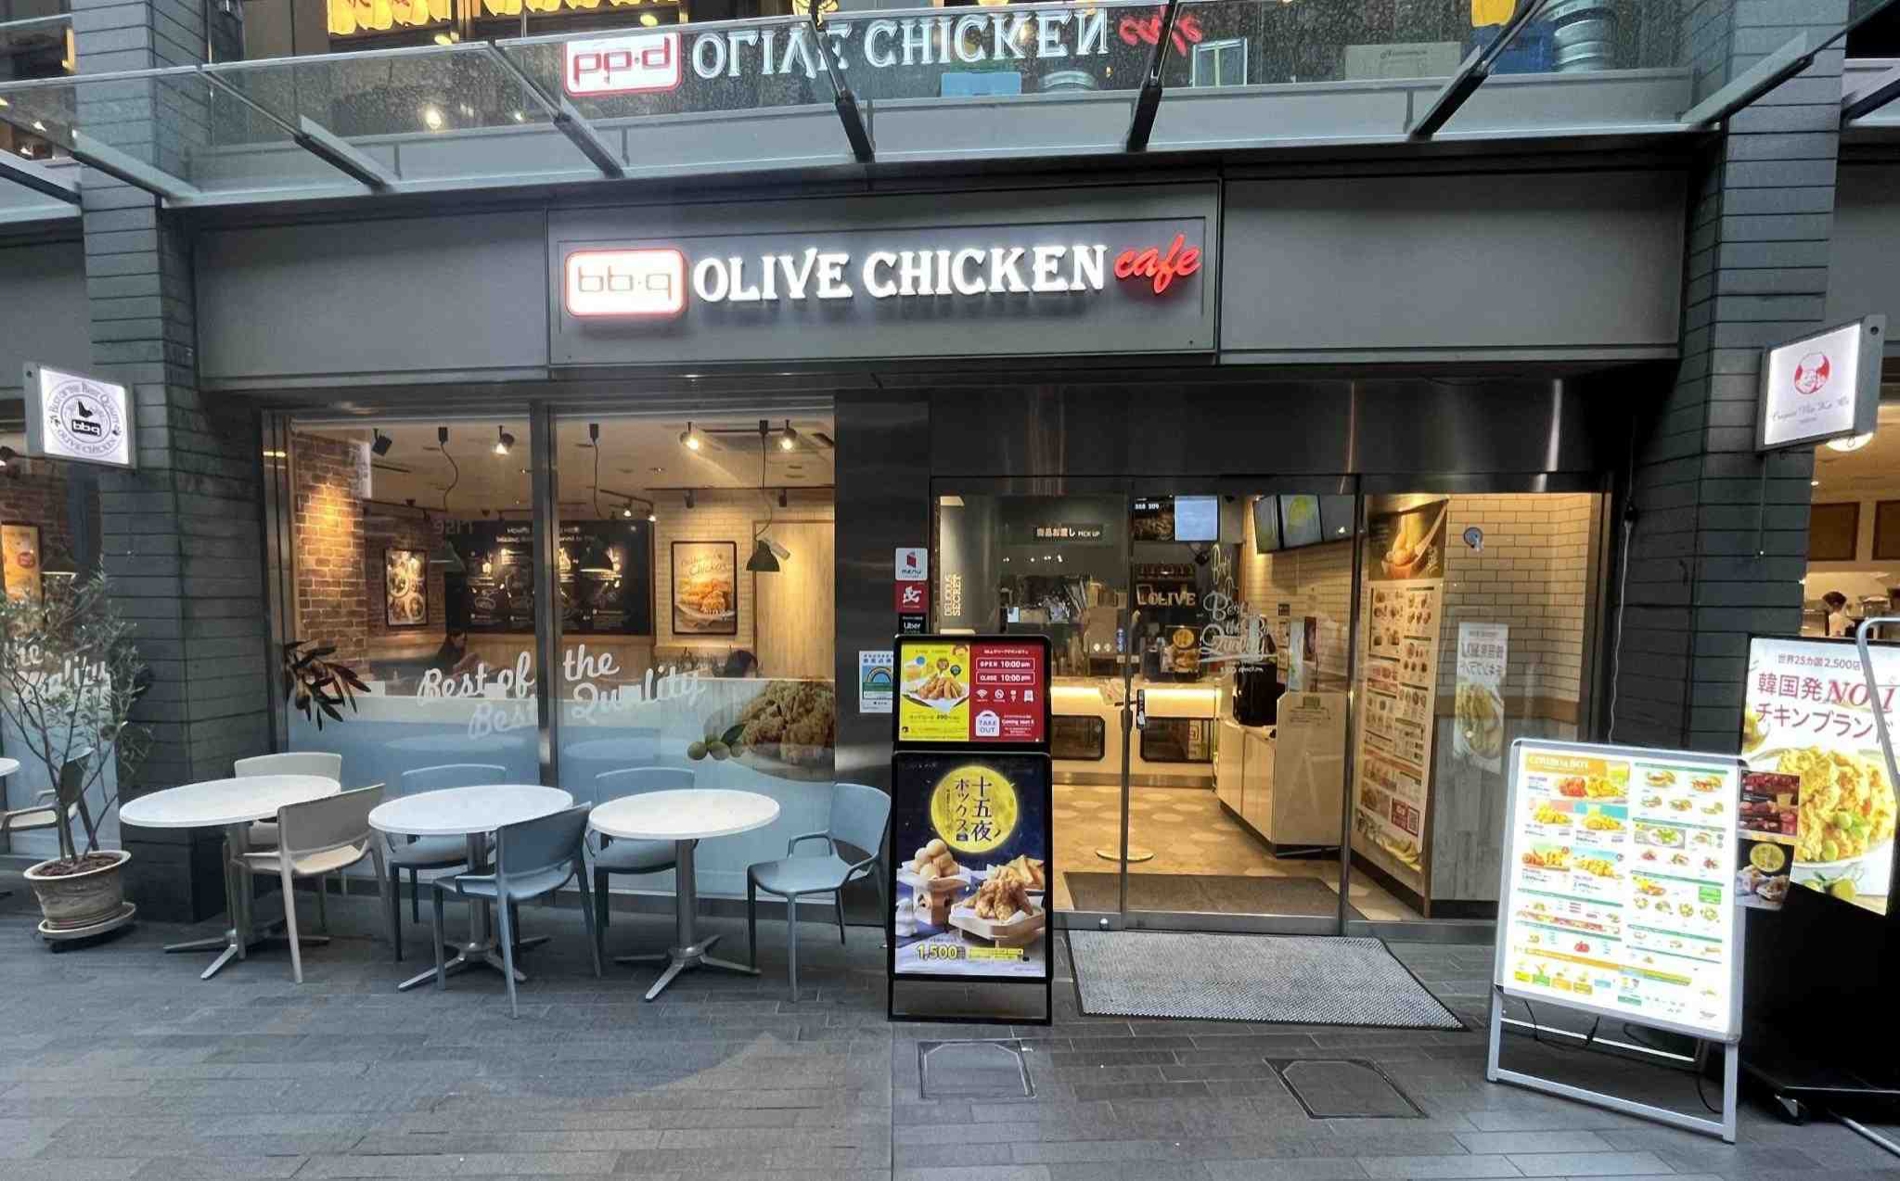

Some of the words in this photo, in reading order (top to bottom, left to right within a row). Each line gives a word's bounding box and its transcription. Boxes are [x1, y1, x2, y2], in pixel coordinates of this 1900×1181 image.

[693, 248, 854, 303] OLIVE
[863, 243, 1107, 299] CHICKEN
[1113, 233, 1203, 296] cafe
[417, 662, 488, 706] Best
[497, 650, 536, 699] of
[562, 643, 621, 682] the
[571, 665, 707, 725] Quality
[979, 674, 998, 682] CLOSE
[979, 726, 996, 734] OUT
[955, 778, 970, 832] ボックス
[971, 775, 993, 842] 十五夜
